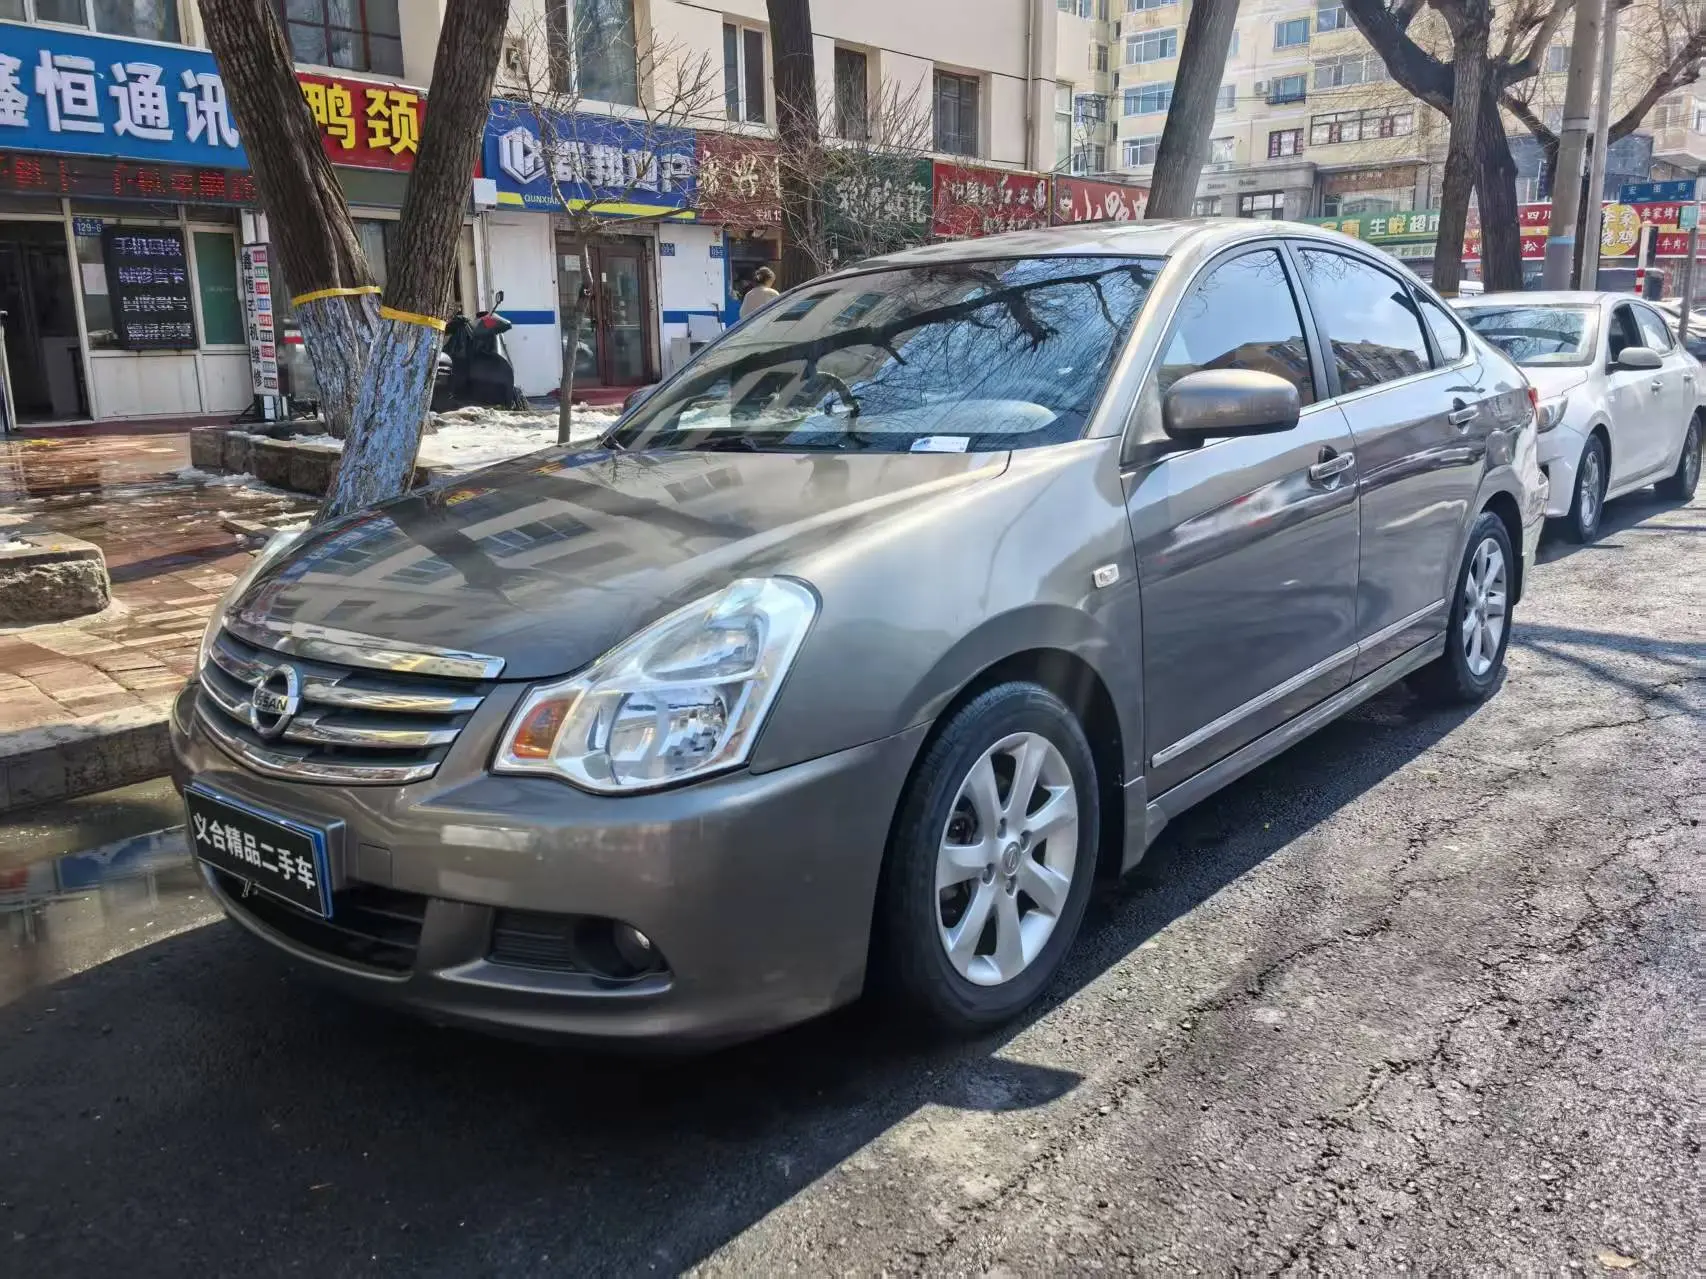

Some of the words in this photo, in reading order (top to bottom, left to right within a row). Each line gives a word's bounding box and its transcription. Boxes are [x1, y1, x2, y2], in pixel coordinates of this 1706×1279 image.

[300, 81, 420, 155] 鸭颈
[193, 813, 316, 889] 义合精品二手车
